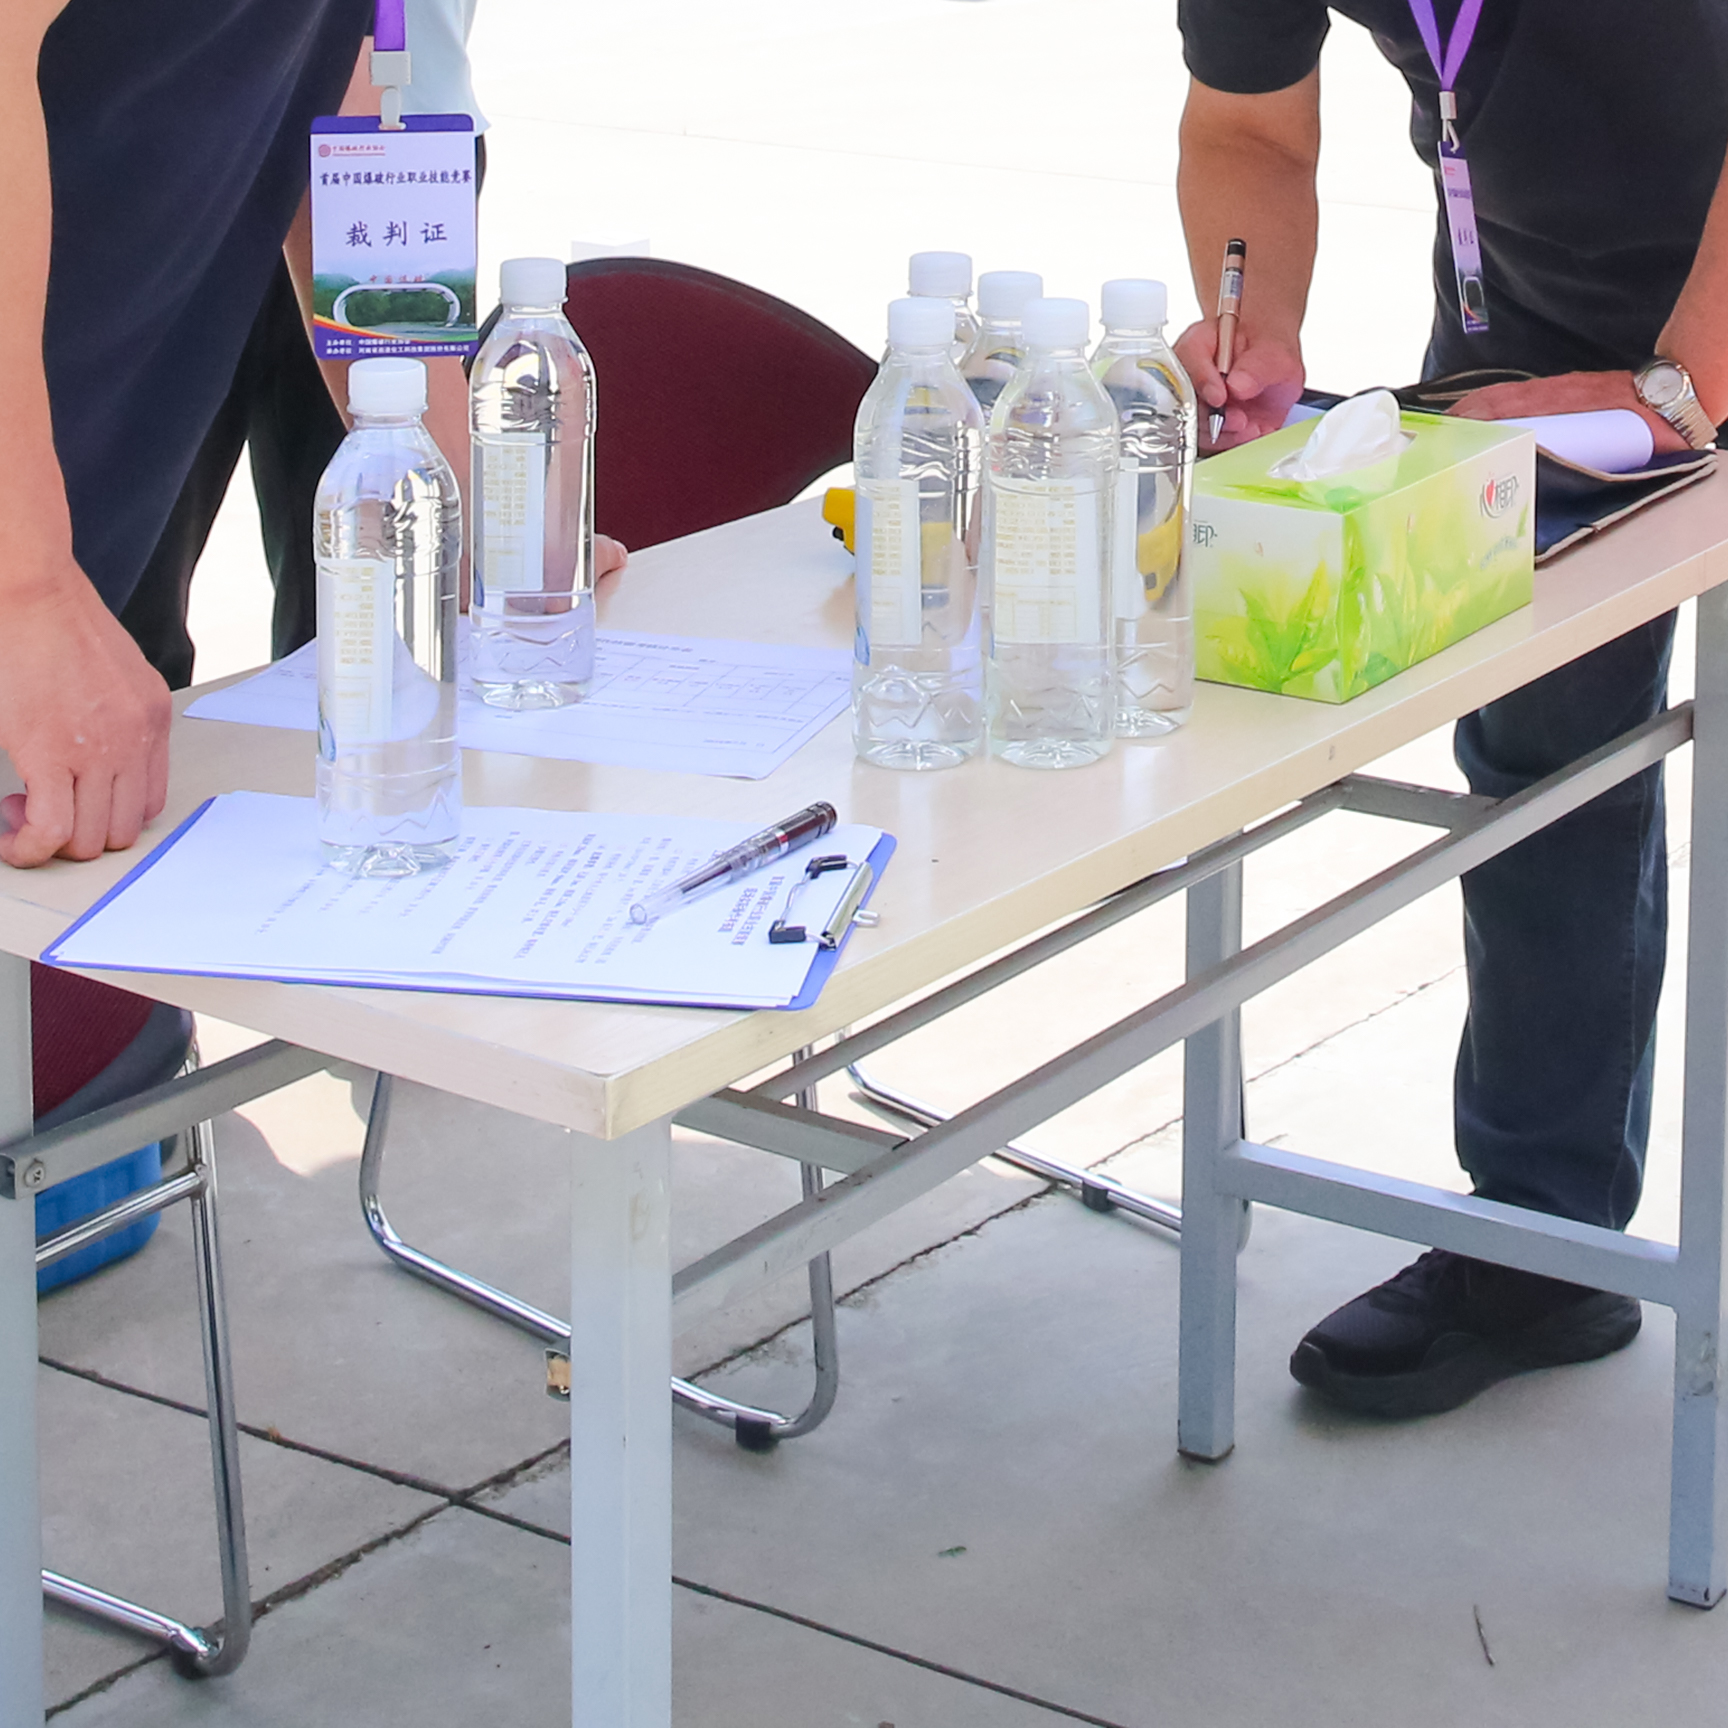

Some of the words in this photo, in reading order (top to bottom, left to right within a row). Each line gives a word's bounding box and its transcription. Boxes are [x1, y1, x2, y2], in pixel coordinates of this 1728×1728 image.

[319, 169, 472, 187] 首届中国爆破行业职业技能竞赛
[345, 220, 448, 248] 裁判证
